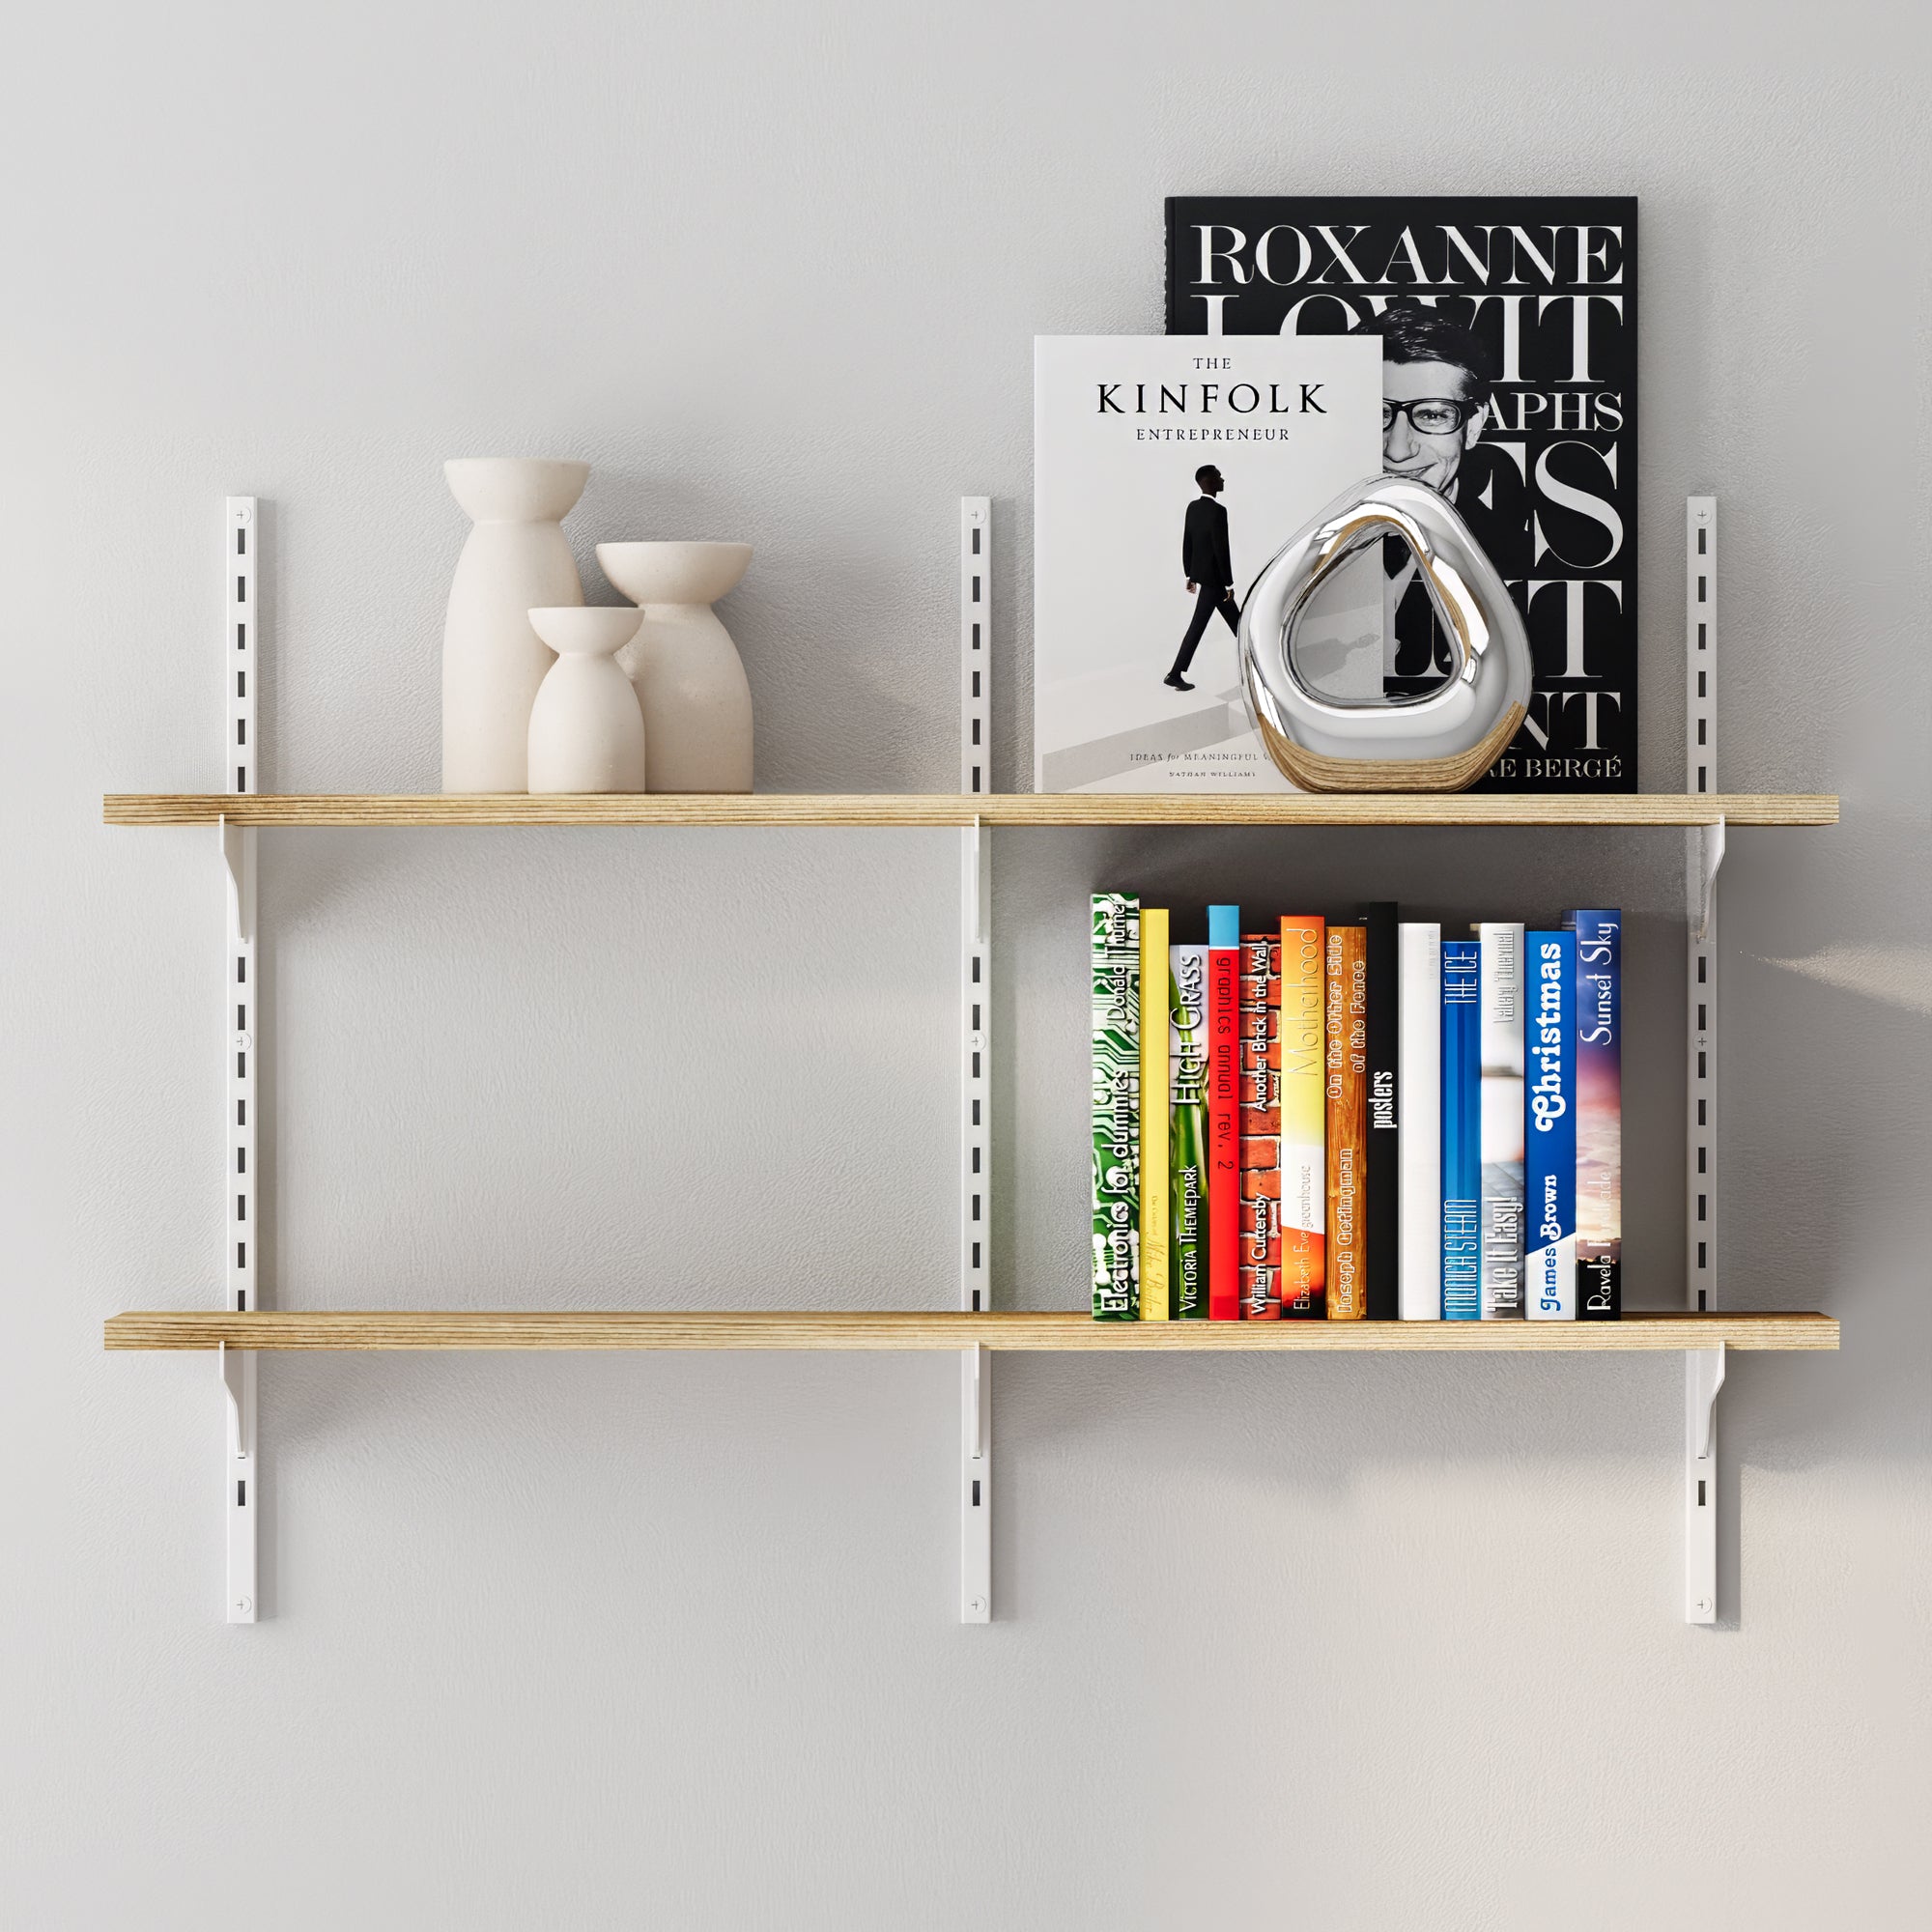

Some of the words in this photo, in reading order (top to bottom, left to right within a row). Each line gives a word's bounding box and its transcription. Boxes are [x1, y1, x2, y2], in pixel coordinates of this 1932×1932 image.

[1190, 225, 1623, 285] ROXANNE
[1193, 357, 1232, 369] THE
[1097, 384, 1327, 413] KINFOLK
[1481, 392, 1624, 432] APHS
[1137, 429, 1290, 440] ENTREPRENEUR
[1167, 753, 1179, 762] for
[1524, 755, 1622, 779] BERGÉ
[1252, 944, 1267, 972] Wall
[1326, 935, 1343, 975] Side
[1444, 952, 1477, 973] ICE
[1579, 923, 1619, 965] Sky
[1170, 953, 1201, 1029] GRASS
[1215, 956, 1231, 1034] graphics
[1252, 976, 1267, 997] the
[1252, 1001, 1267, 1013] in
[1286, 928, 1319, 1076] Motherhood
[1326, 981, 1343, 1035] Other
[1349, 961, 1364, 1013] Fence
[1444, 979, 1477, 1005] THE
[1579, 974, 1612, 1045] Sunset
[1252, 1017, 1267, 1052] Brick
[1326, 1040, 1343, 1069] the
[1349, 1020, 1364, 1049] the
[1532, 943, 1566, 1132] Christmas
[1218, 1043, 1231, 1100] annual
[1349, 1051, 1364, 1073] of
[1252, 1058, 1267, 1111] Another
[1326, 1073, 1343, 1098] On
[1368, 1071, 1397, 1128] posters
[1101, 1069, 1129, 1158] dummies
[1218, 1112, 1232, 1149] rev.
[1101, 1171, 1128, 1193] for
[1218, 1161, 1233, 1170] 2
[1252, 1193, 1269, 1260] Cuttersby
[1444, 1199, 1477, 1250] STEAM
[1487, 1197, 1523, 1243] Easy!
[1540, 1174, 1562, 1241] Brown
[1101, 1201, 1129, 1311] Electronics
[1487, 1247, 1518, 1264] It
[1252, 1264, 1267, 1314] William
[1293, 1259, 1310, 1310] Elizabeth
[1487, 1265, 1518, 1312] Take
[1540, 1248, 1562, 1311] James
[1587, 1255, 1611, 1310] Ravela
